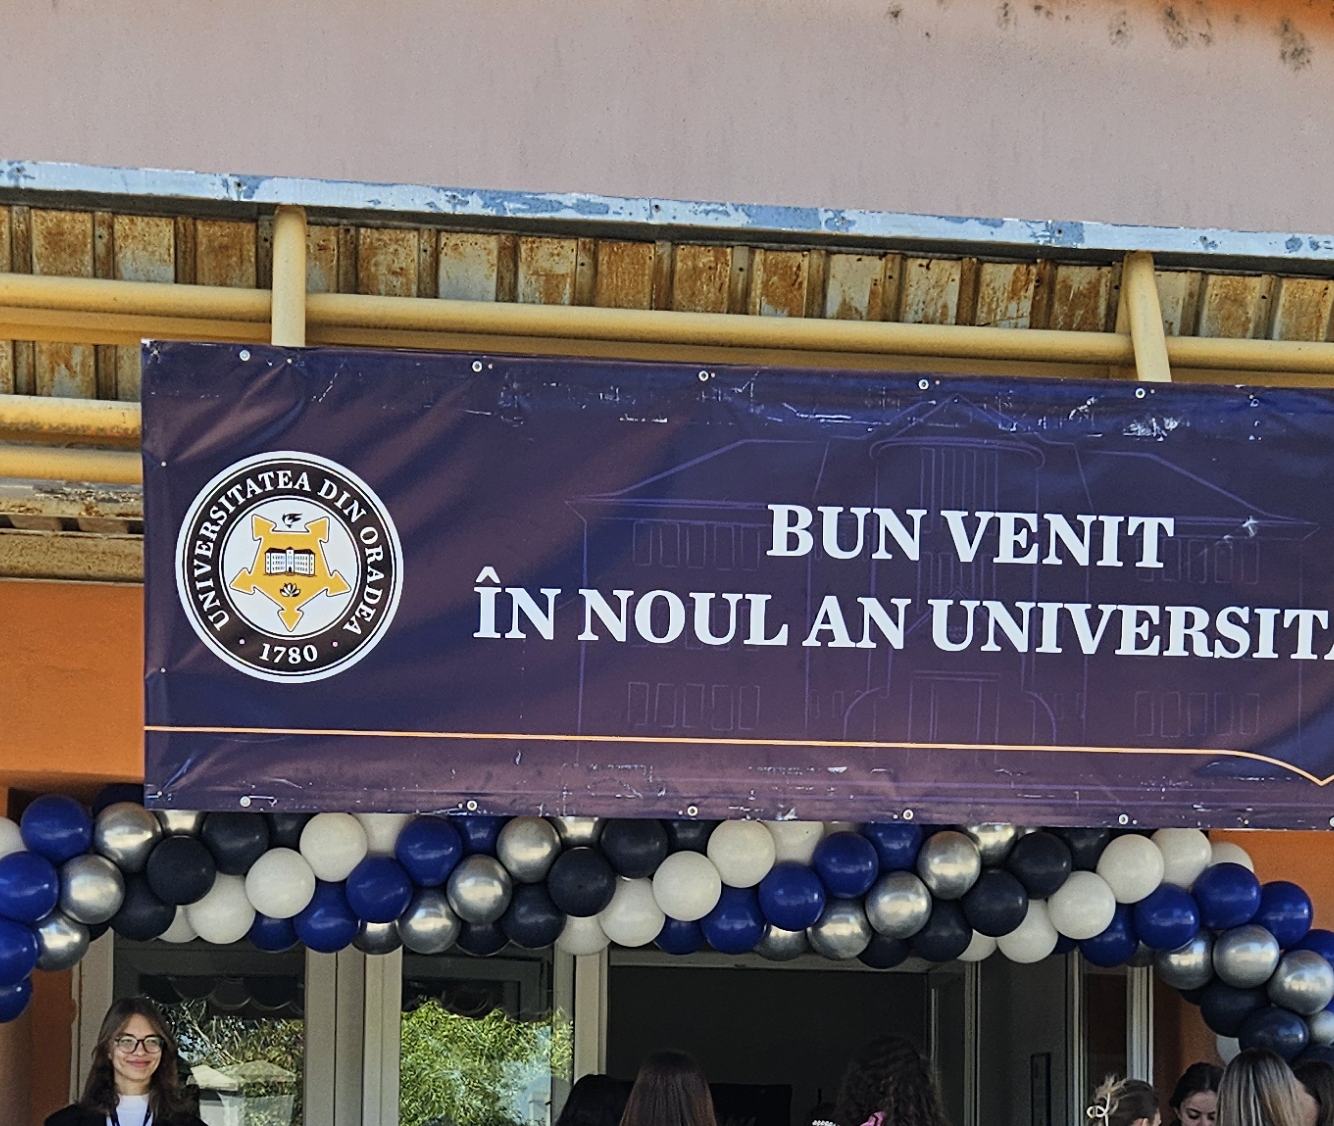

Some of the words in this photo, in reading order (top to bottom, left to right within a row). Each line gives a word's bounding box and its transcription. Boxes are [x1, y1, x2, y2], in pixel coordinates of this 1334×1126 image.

[193, 470, 312, 632] UNIVERSITATEA
[317, 478, 367, 523] DIN
[342, 526, 385, 636] ORADEA
[766, 503, 928, 562] BUN
[940, 509, 1175, 569] VENIT
[472, 565, 562, 641] ÎN
[577, 587, 789, 646] NOUL
[801, 595, 912, 650] AN
[258, 643, 319, 665] 1780
